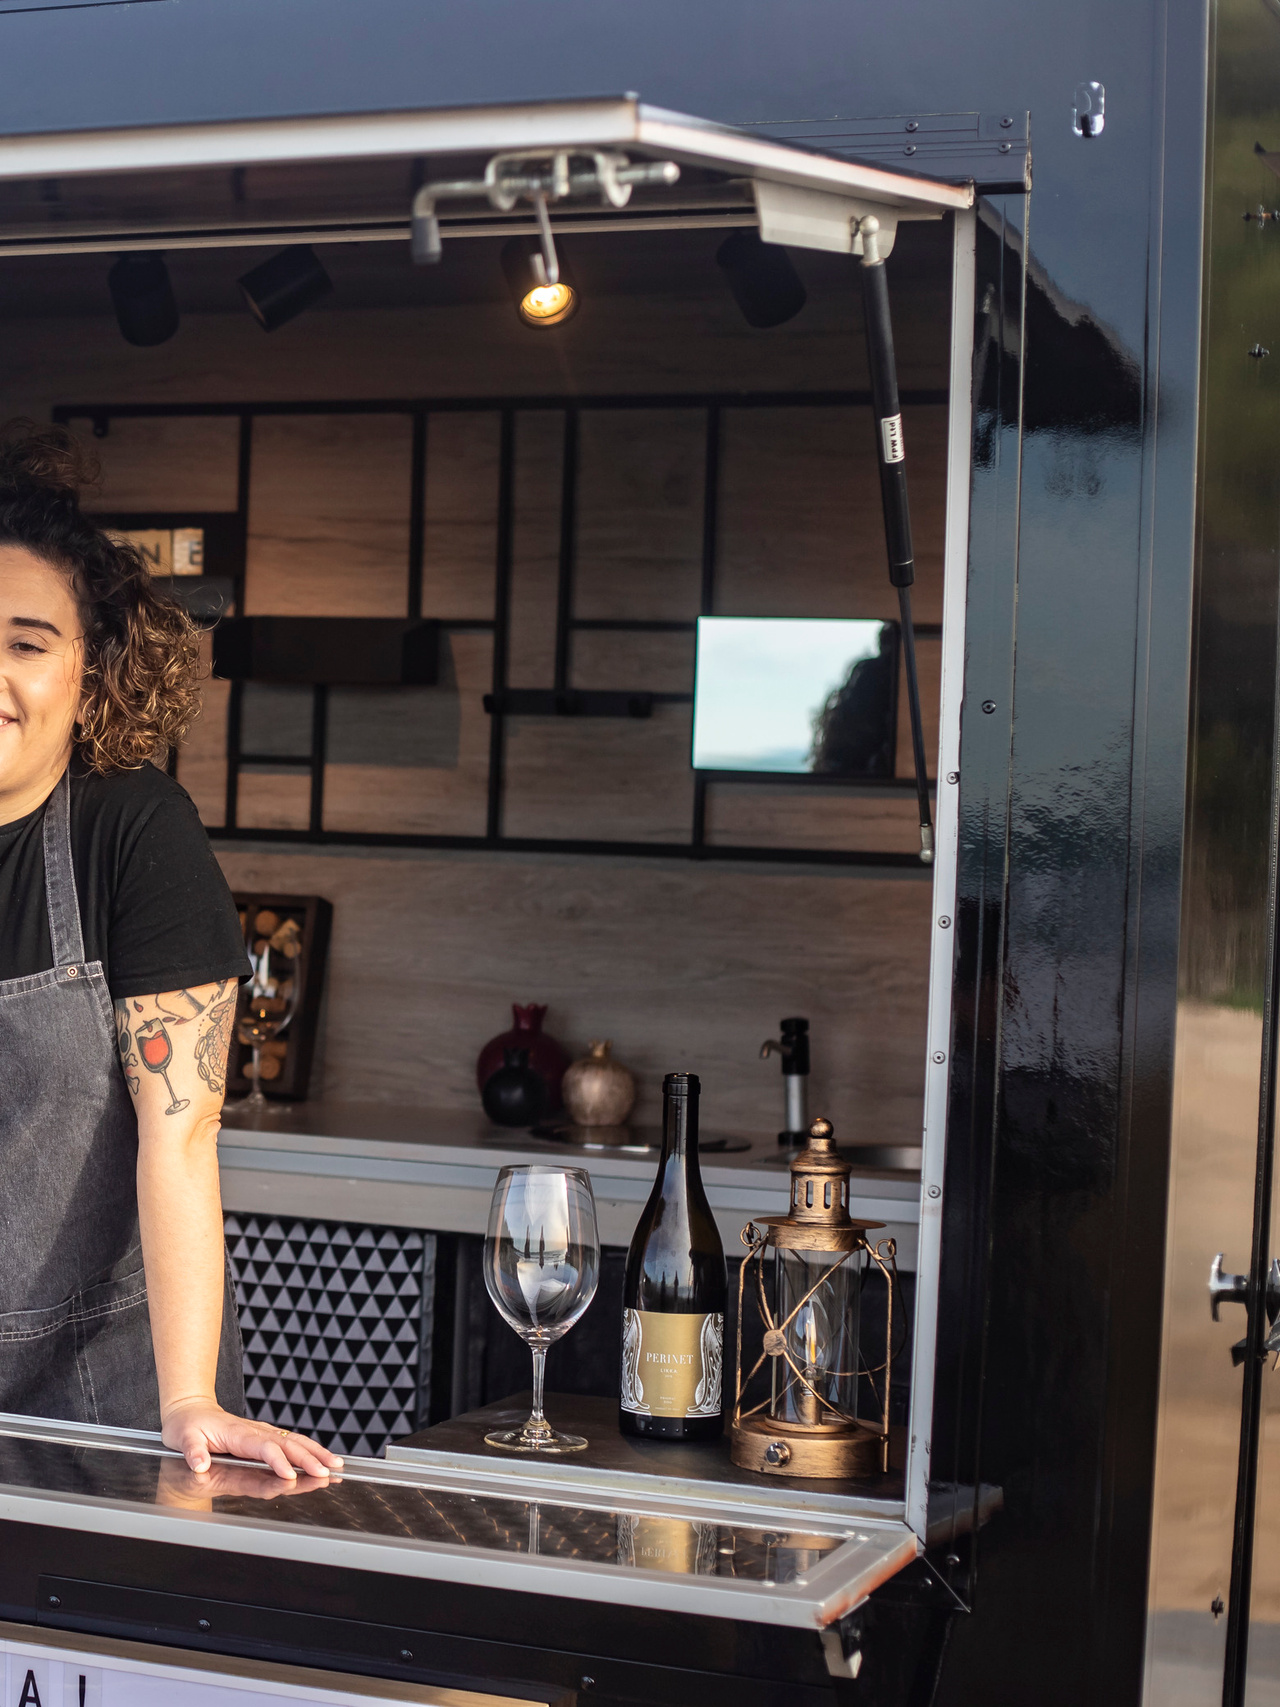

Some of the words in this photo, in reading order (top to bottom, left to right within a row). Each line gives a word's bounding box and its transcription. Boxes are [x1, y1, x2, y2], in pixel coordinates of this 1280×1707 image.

[889, 422, 897, 437] Ltd
[139, 541, 204, 566] NE
[646, 1352, 693, 1365] PERINET
